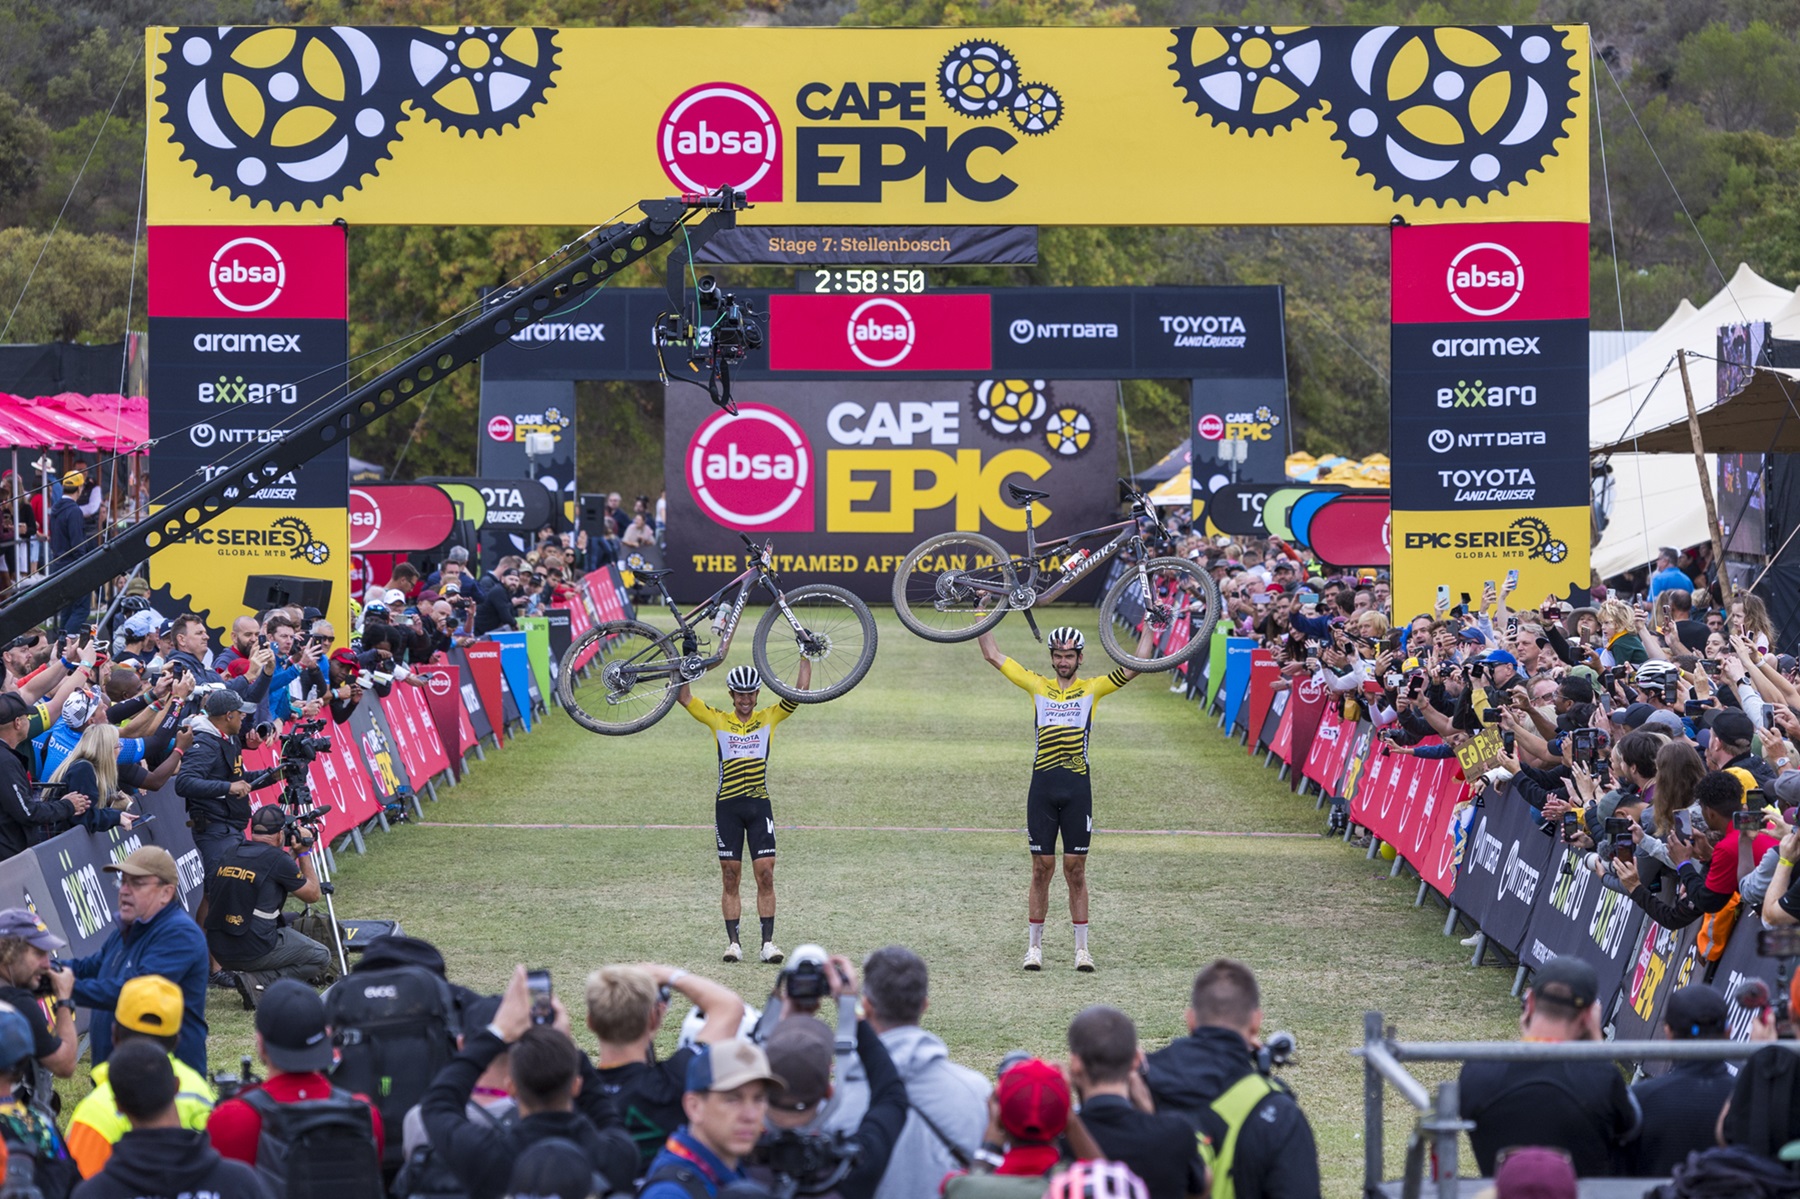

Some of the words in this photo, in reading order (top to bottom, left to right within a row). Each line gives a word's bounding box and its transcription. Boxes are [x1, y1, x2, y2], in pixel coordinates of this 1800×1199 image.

[796, 82, 926, 121] CAPE
[677, 121, 762, 155] absa
[796, 126, 1019, 203] EPIC
[768, 238, 817, 255] Stage
[822, 238, 837, 252] 7:
[841, 237, 951, 252] Stellenbosch
[218, 259, 277, 283] absa
[1456, 264, 1515, 288] absa
[815, 270, 925, 293] 2:58:50
[510, 323, 605, 342] aramex
[855, 318, 907, 341] absa
[1037, 324, 1071, 338] NTT
[1159, 316, 1246, 333] TOYOTA
[193, 333, 301, 352] aramex
[1432, 337, 1541, 357] aramex
[198, 375, 297, 404] exxaro
[1437, 380, 1537, 408] exxaro
[515, 414, 543, 425] CAPE
[826, 401, 960, 446] CAPE
[1225, 413, 1254, 424] CAPE
[219, 429, 256, 443] NTT
[1225, 423, 1273, 441] EPIC
[1458, 433, 1496, 447] NTT
[706, 443, 794, 481] absa
[1438, 468, 1535, 488] TOYOTA
[826, 448, 1053, 533] EPIC
[1485, 488, 1536, 502] CRUISER
[217, 529, 297, 546] SERIES
[1405, 532, 1451, 549] EPIC
[1454, 530, 1535, 548] SERIES
[218, 549, 260, 557] GLOBAL
[1455, 551, 1498, 559] GLOBAL
[1502, 550, 1525, 558] MTB
[692, 555, 737, 573] THE
[469, 651, 498, 659] aramex
[431, 677, 449, 687] absa
[1301, 686, 1319, 695] absa
[1046, 702, 1080, 710] TOYOTA
[729, 734, 760, 743] TOYOTA
[1457, 744, 1479, 770] GO
[216, 866, 257, 884] MEDIA
[59, 849, 113, 940] exxaro
